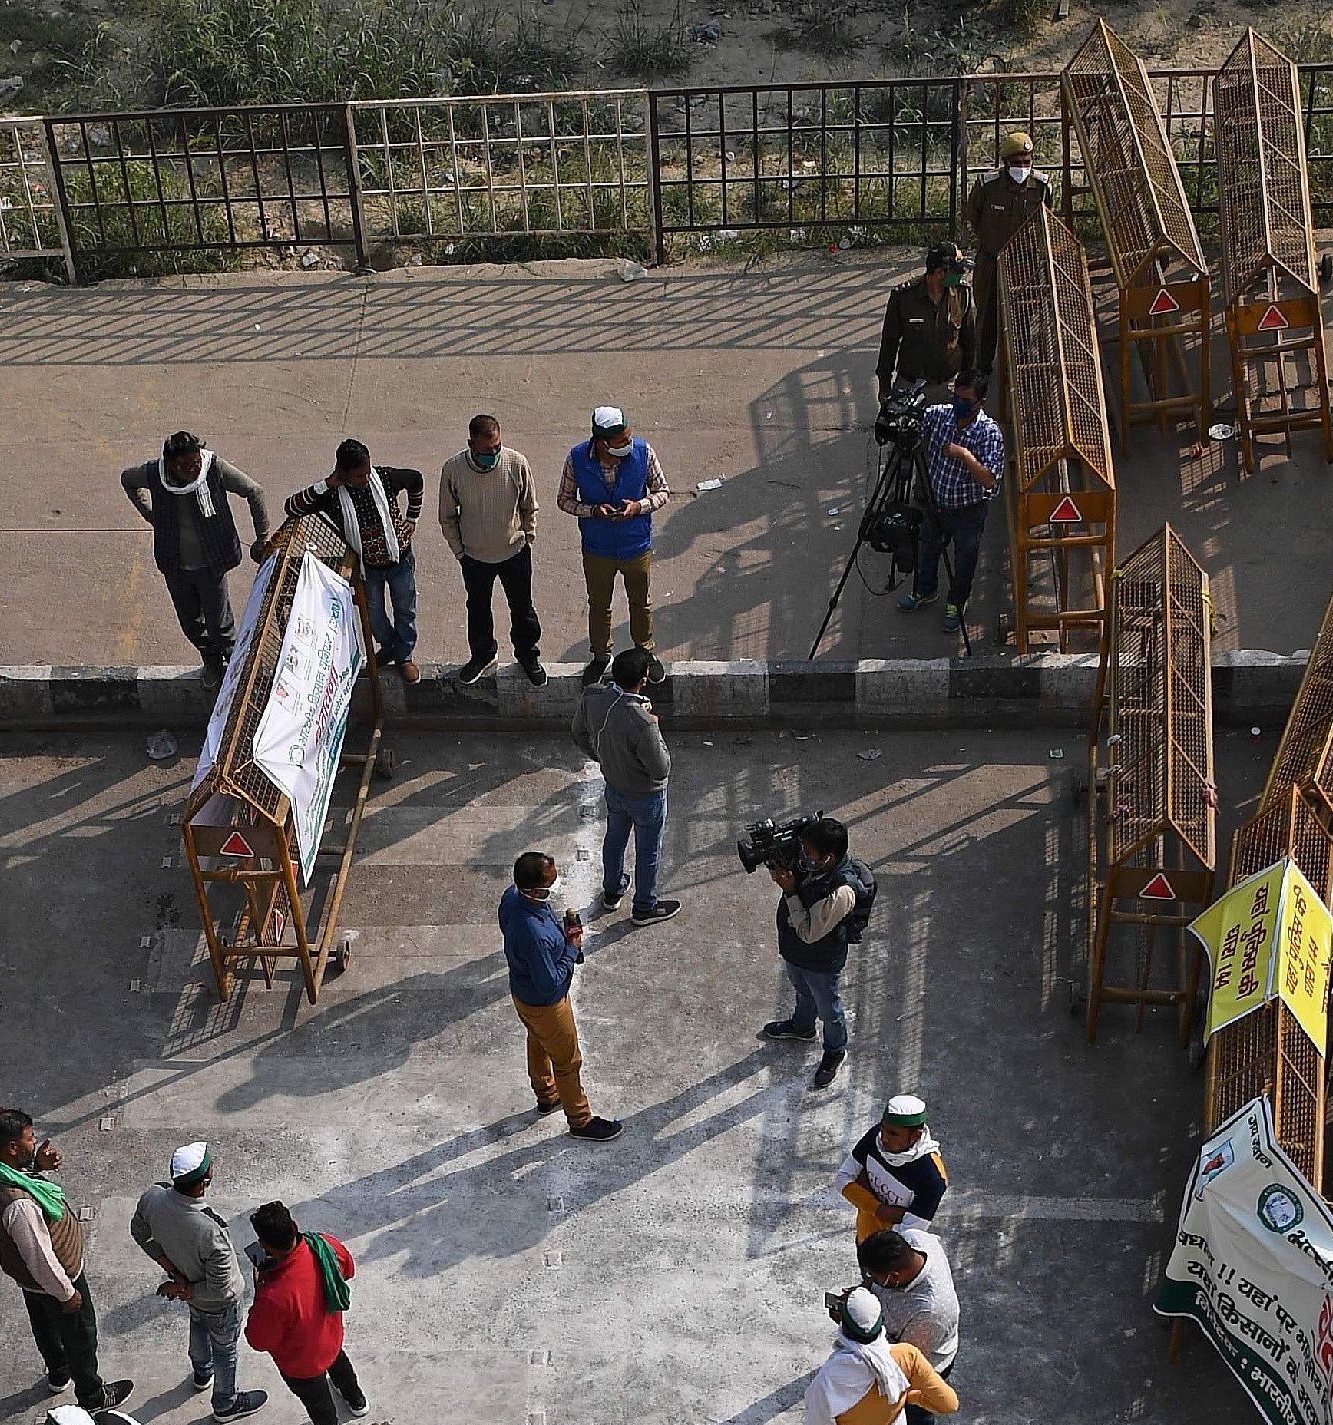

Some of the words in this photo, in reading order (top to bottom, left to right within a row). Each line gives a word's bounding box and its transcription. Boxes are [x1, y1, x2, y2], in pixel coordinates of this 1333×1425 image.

[1222, 924, 1240, 960] धारा
[1240, 917, 1267, 973] पुलिस
[1215, 964, 1232, 990] 144
[1236, 974, 1259, 1000] की
[1218, 1291, 1291, 1363] किसानों
[1238, 1276, 1279, 1313] यहां
[1276, 1304, 1298, 1335] पर
